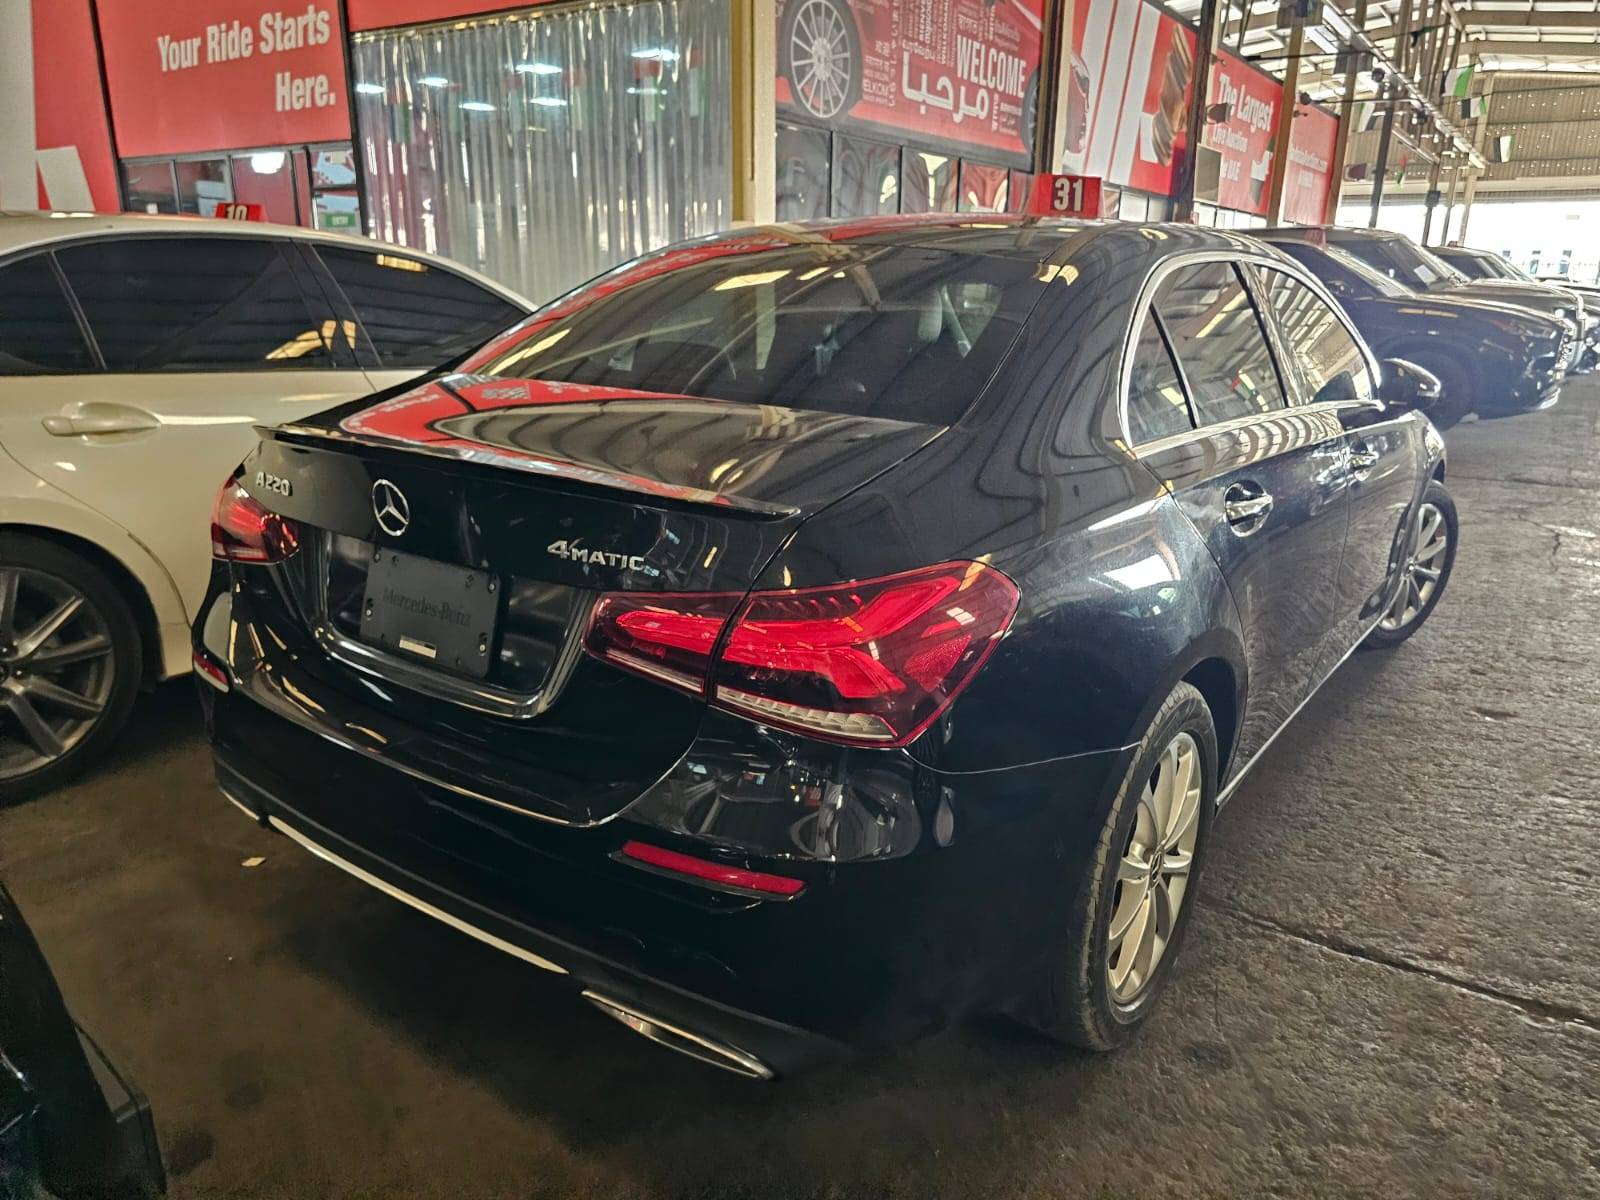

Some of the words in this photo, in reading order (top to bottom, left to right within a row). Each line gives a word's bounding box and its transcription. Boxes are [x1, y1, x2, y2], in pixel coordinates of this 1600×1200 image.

[157, 35, 202, 72] Your
[206, 20, 254, 63] Ride
[258, 4, 331, 54] Starts
[902, 50, 990, 124] مرحبا
[957, 34, 1027, 99] WELCOME
[275, 71, 337, 112] Here.
[1217, 73, 1238, 116] The
[1236, 84, 1274, 133] Largest
[226, 205, 248, 220] 10
[1053, 176, 1083, 212] 31
[547, 538, 645, 572] 4MATIC
[383, 587, 472, 629] Mercedes-Benz
